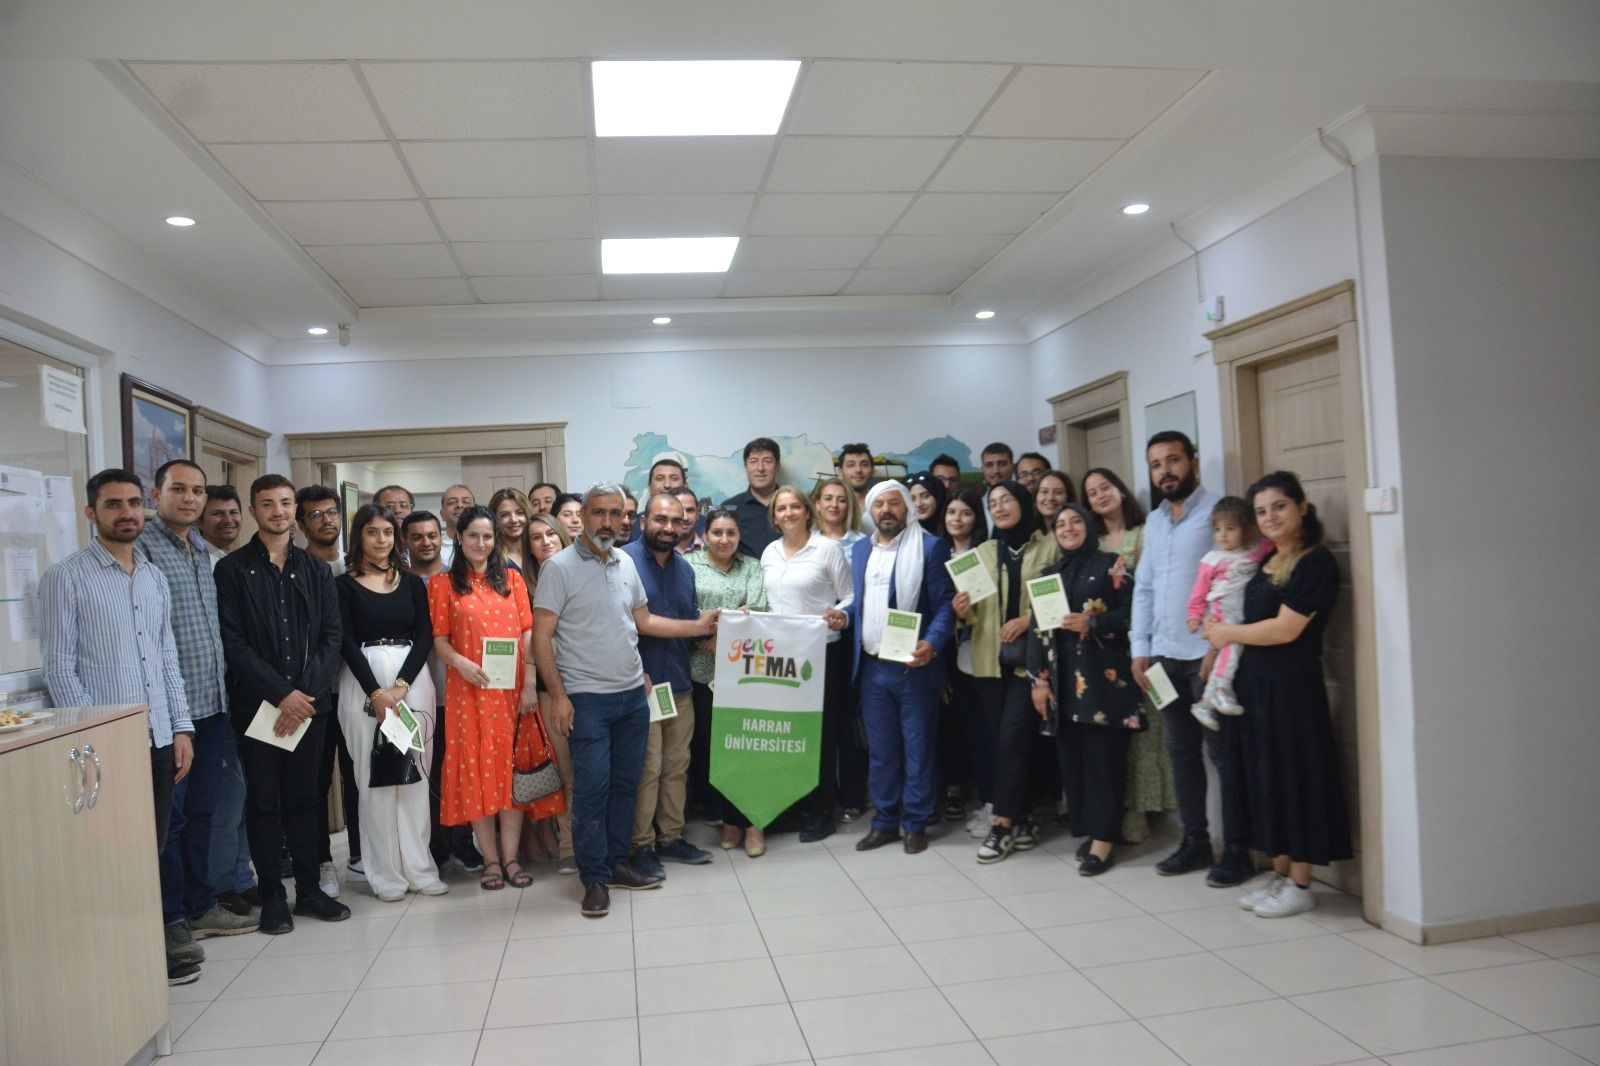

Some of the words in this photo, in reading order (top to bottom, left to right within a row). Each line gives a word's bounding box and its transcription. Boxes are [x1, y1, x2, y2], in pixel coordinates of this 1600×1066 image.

[728, 639, 774, 662] genç
[742, 654, 797, 677] TEMA
[743, 718, 791, 733] HARRAN
[724, 734, 806, 752] ÜNİVERSİTESİ
